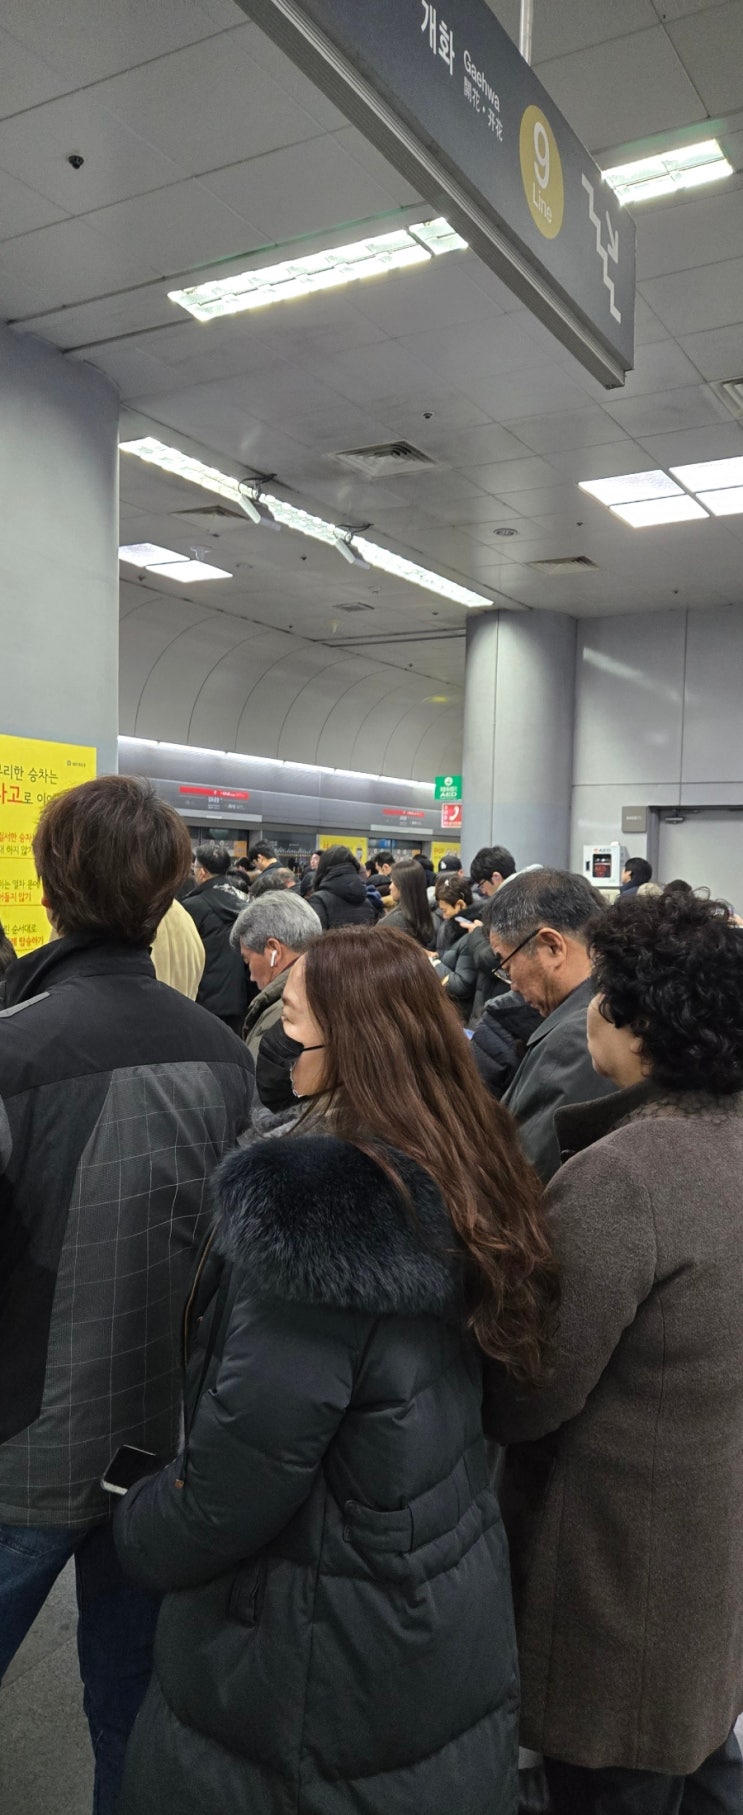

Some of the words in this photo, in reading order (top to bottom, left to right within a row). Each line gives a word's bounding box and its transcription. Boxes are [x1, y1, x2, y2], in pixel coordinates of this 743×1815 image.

[420, 0, 455, 76] 개화
[463, 49, 500, 112] Gaehwa
[533, 121, 549, 189] 9
[532, 182, 552, 223] Line
[27, 767, 58, 785] 승차는
[12, 879, 25, 890] 열차
[18, 892, 32, 902] 않기
[12, 924, 37, 935] 순서대로
[19, 936, 44, 947] 탑승하기
